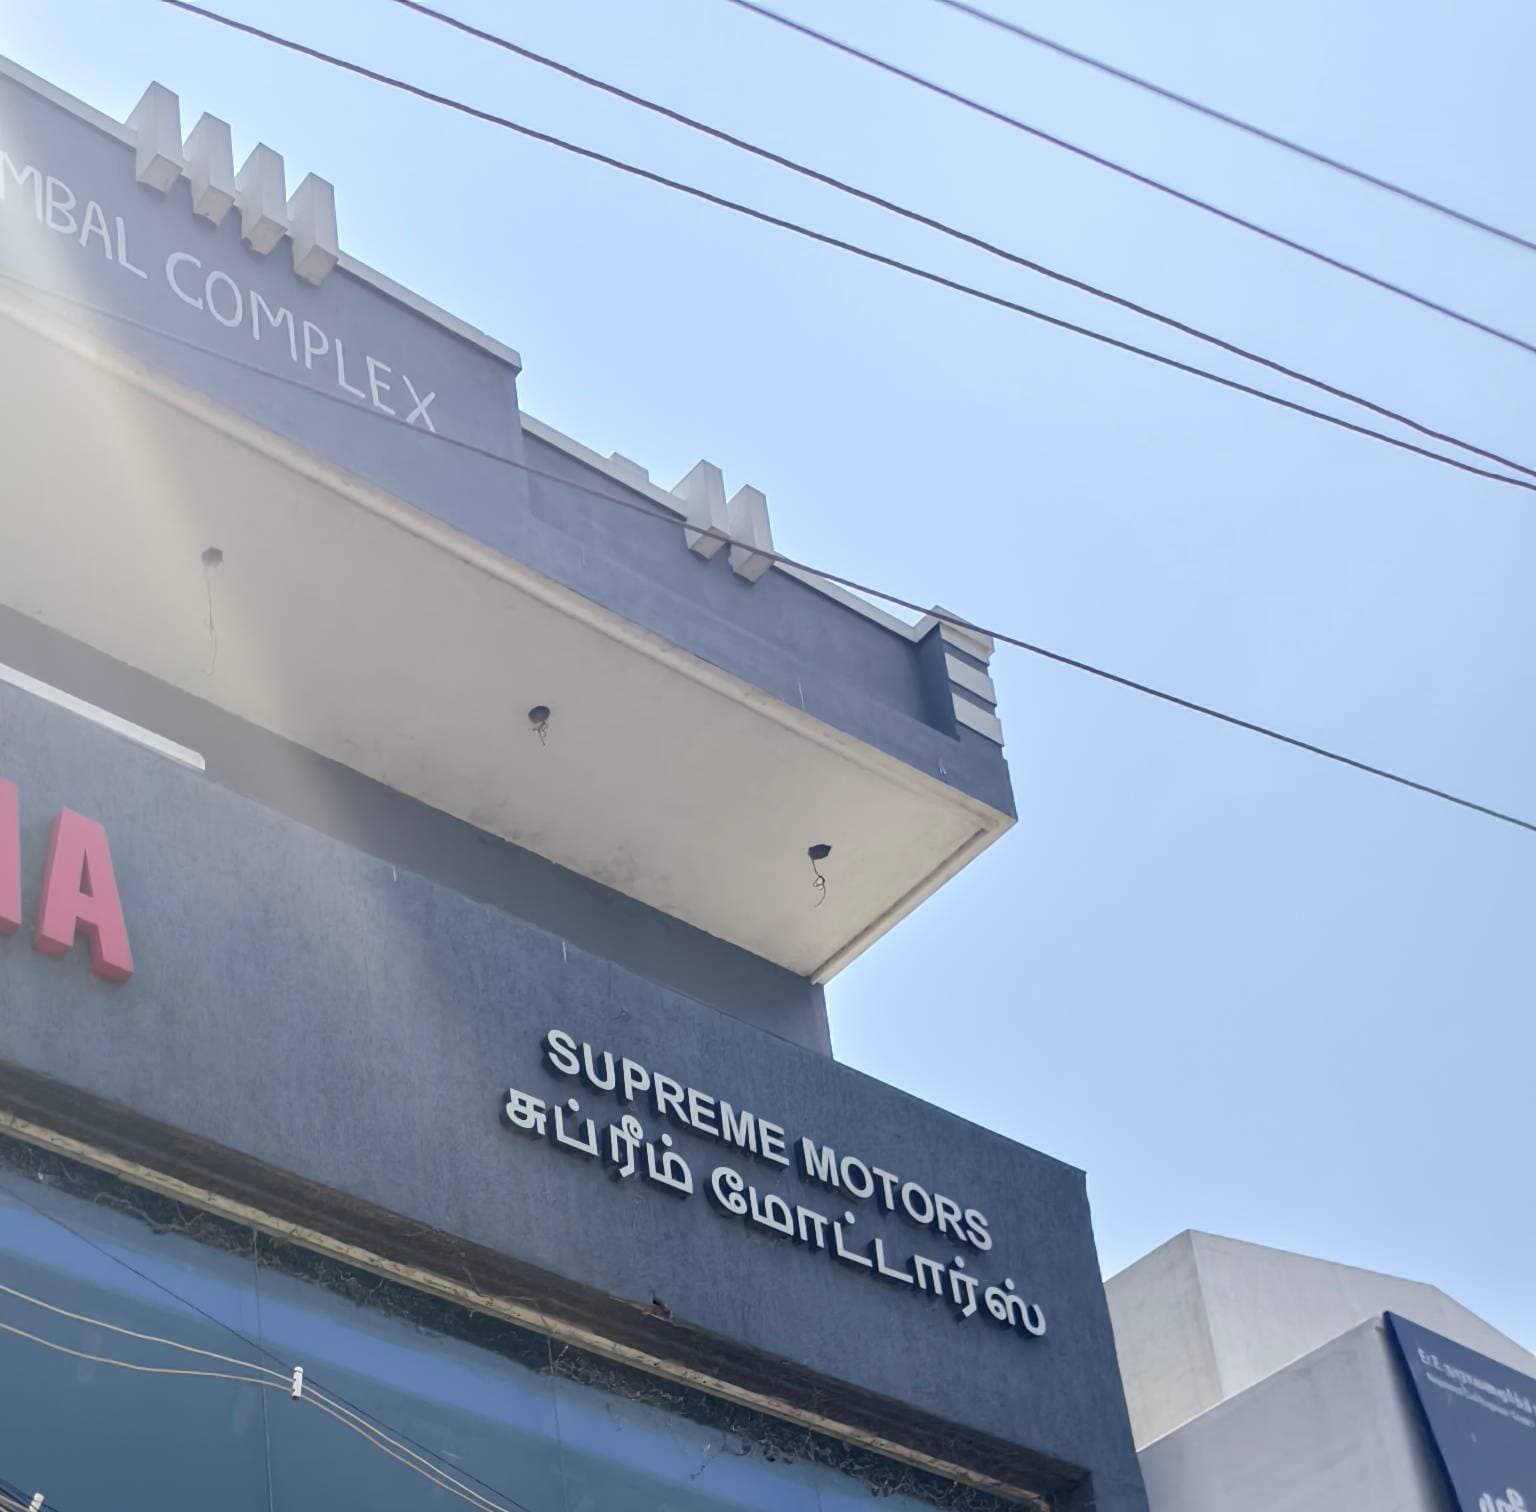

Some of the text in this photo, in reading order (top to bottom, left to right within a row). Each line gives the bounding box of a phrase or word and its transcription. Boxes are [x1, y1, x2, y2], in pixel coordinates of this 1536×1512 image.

[165, 251, 438, 433] COMPLEX
[505, 1087, 1047, 1337] சுப்ரீம் மோட்டார்ஸ்
[546, 1029, 992, 1251] SUPREME MOTORS
